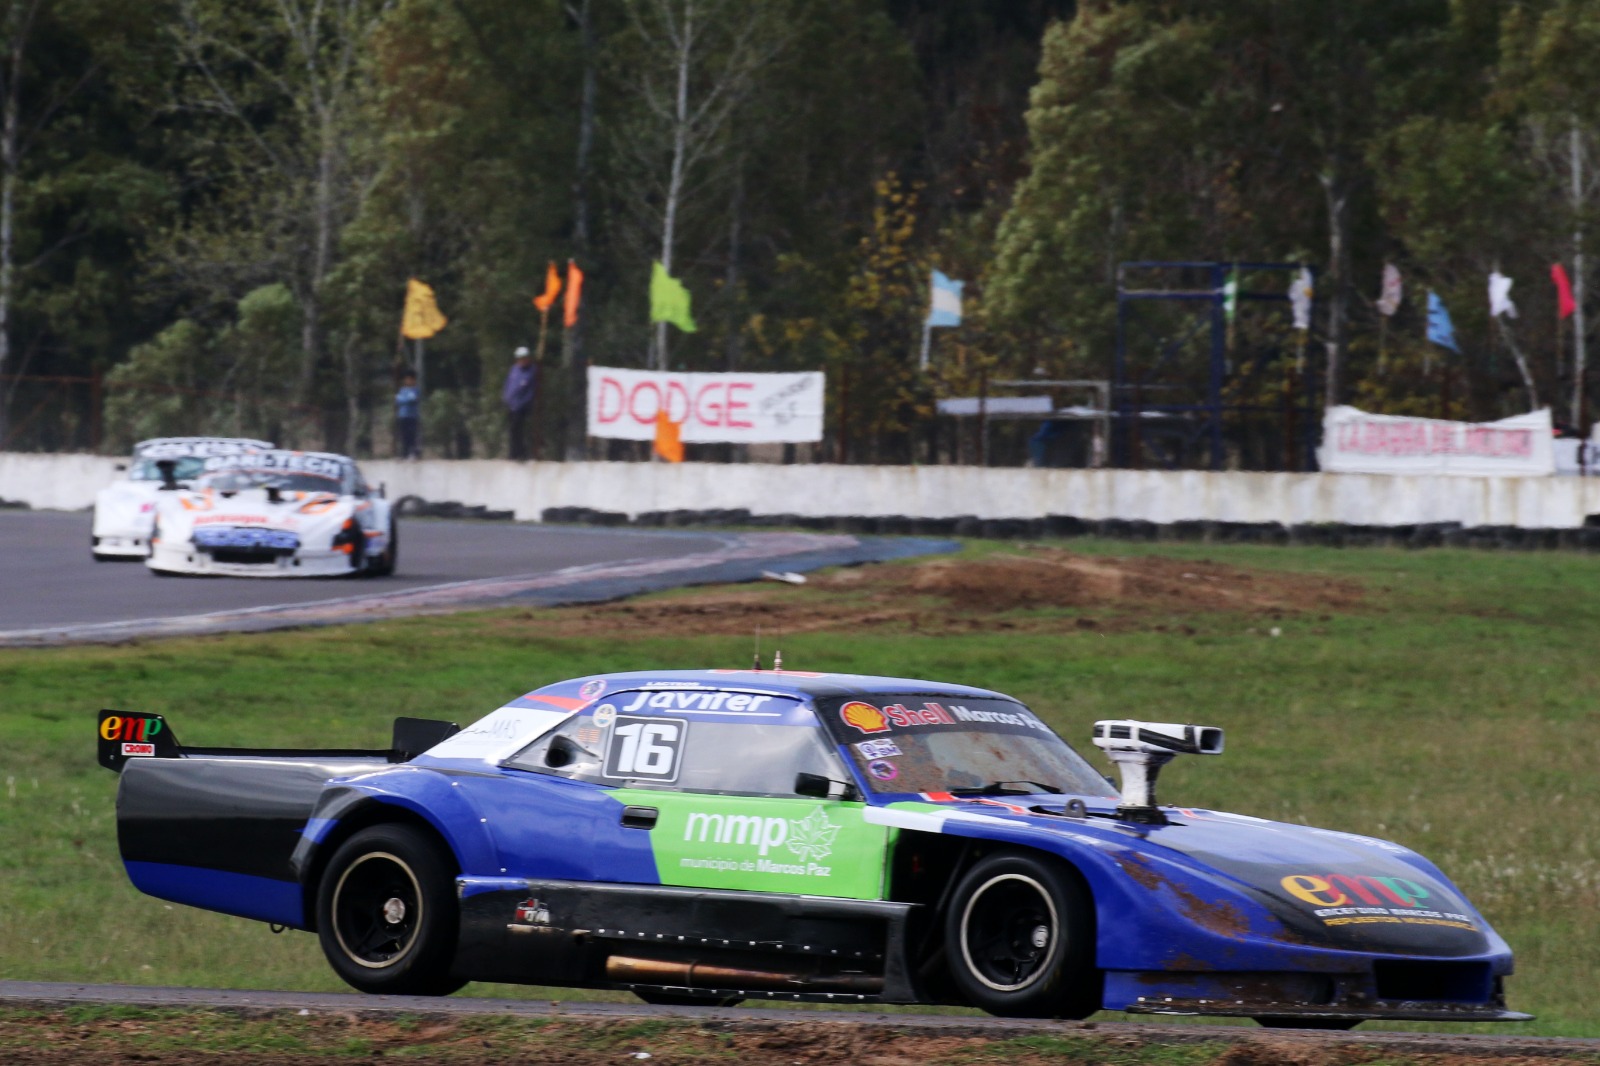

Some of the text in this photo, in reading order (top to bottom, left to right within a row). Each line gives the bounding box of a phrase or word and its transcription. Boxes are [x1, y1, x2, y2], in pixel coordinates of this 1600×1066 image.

[598, 376, 756, 429] DODGE
[100, 715, 162, 742] emp
[883, 702, 956, 727] Shell
[949, 705, 1026, 727] Marcos
[614, 722, 678, 775] 16
[683, 811, 788, 856] mmp
[680, 856, 832, 877] municipio de Marcos Paz
[1280, 873, 1430, 909] emp
